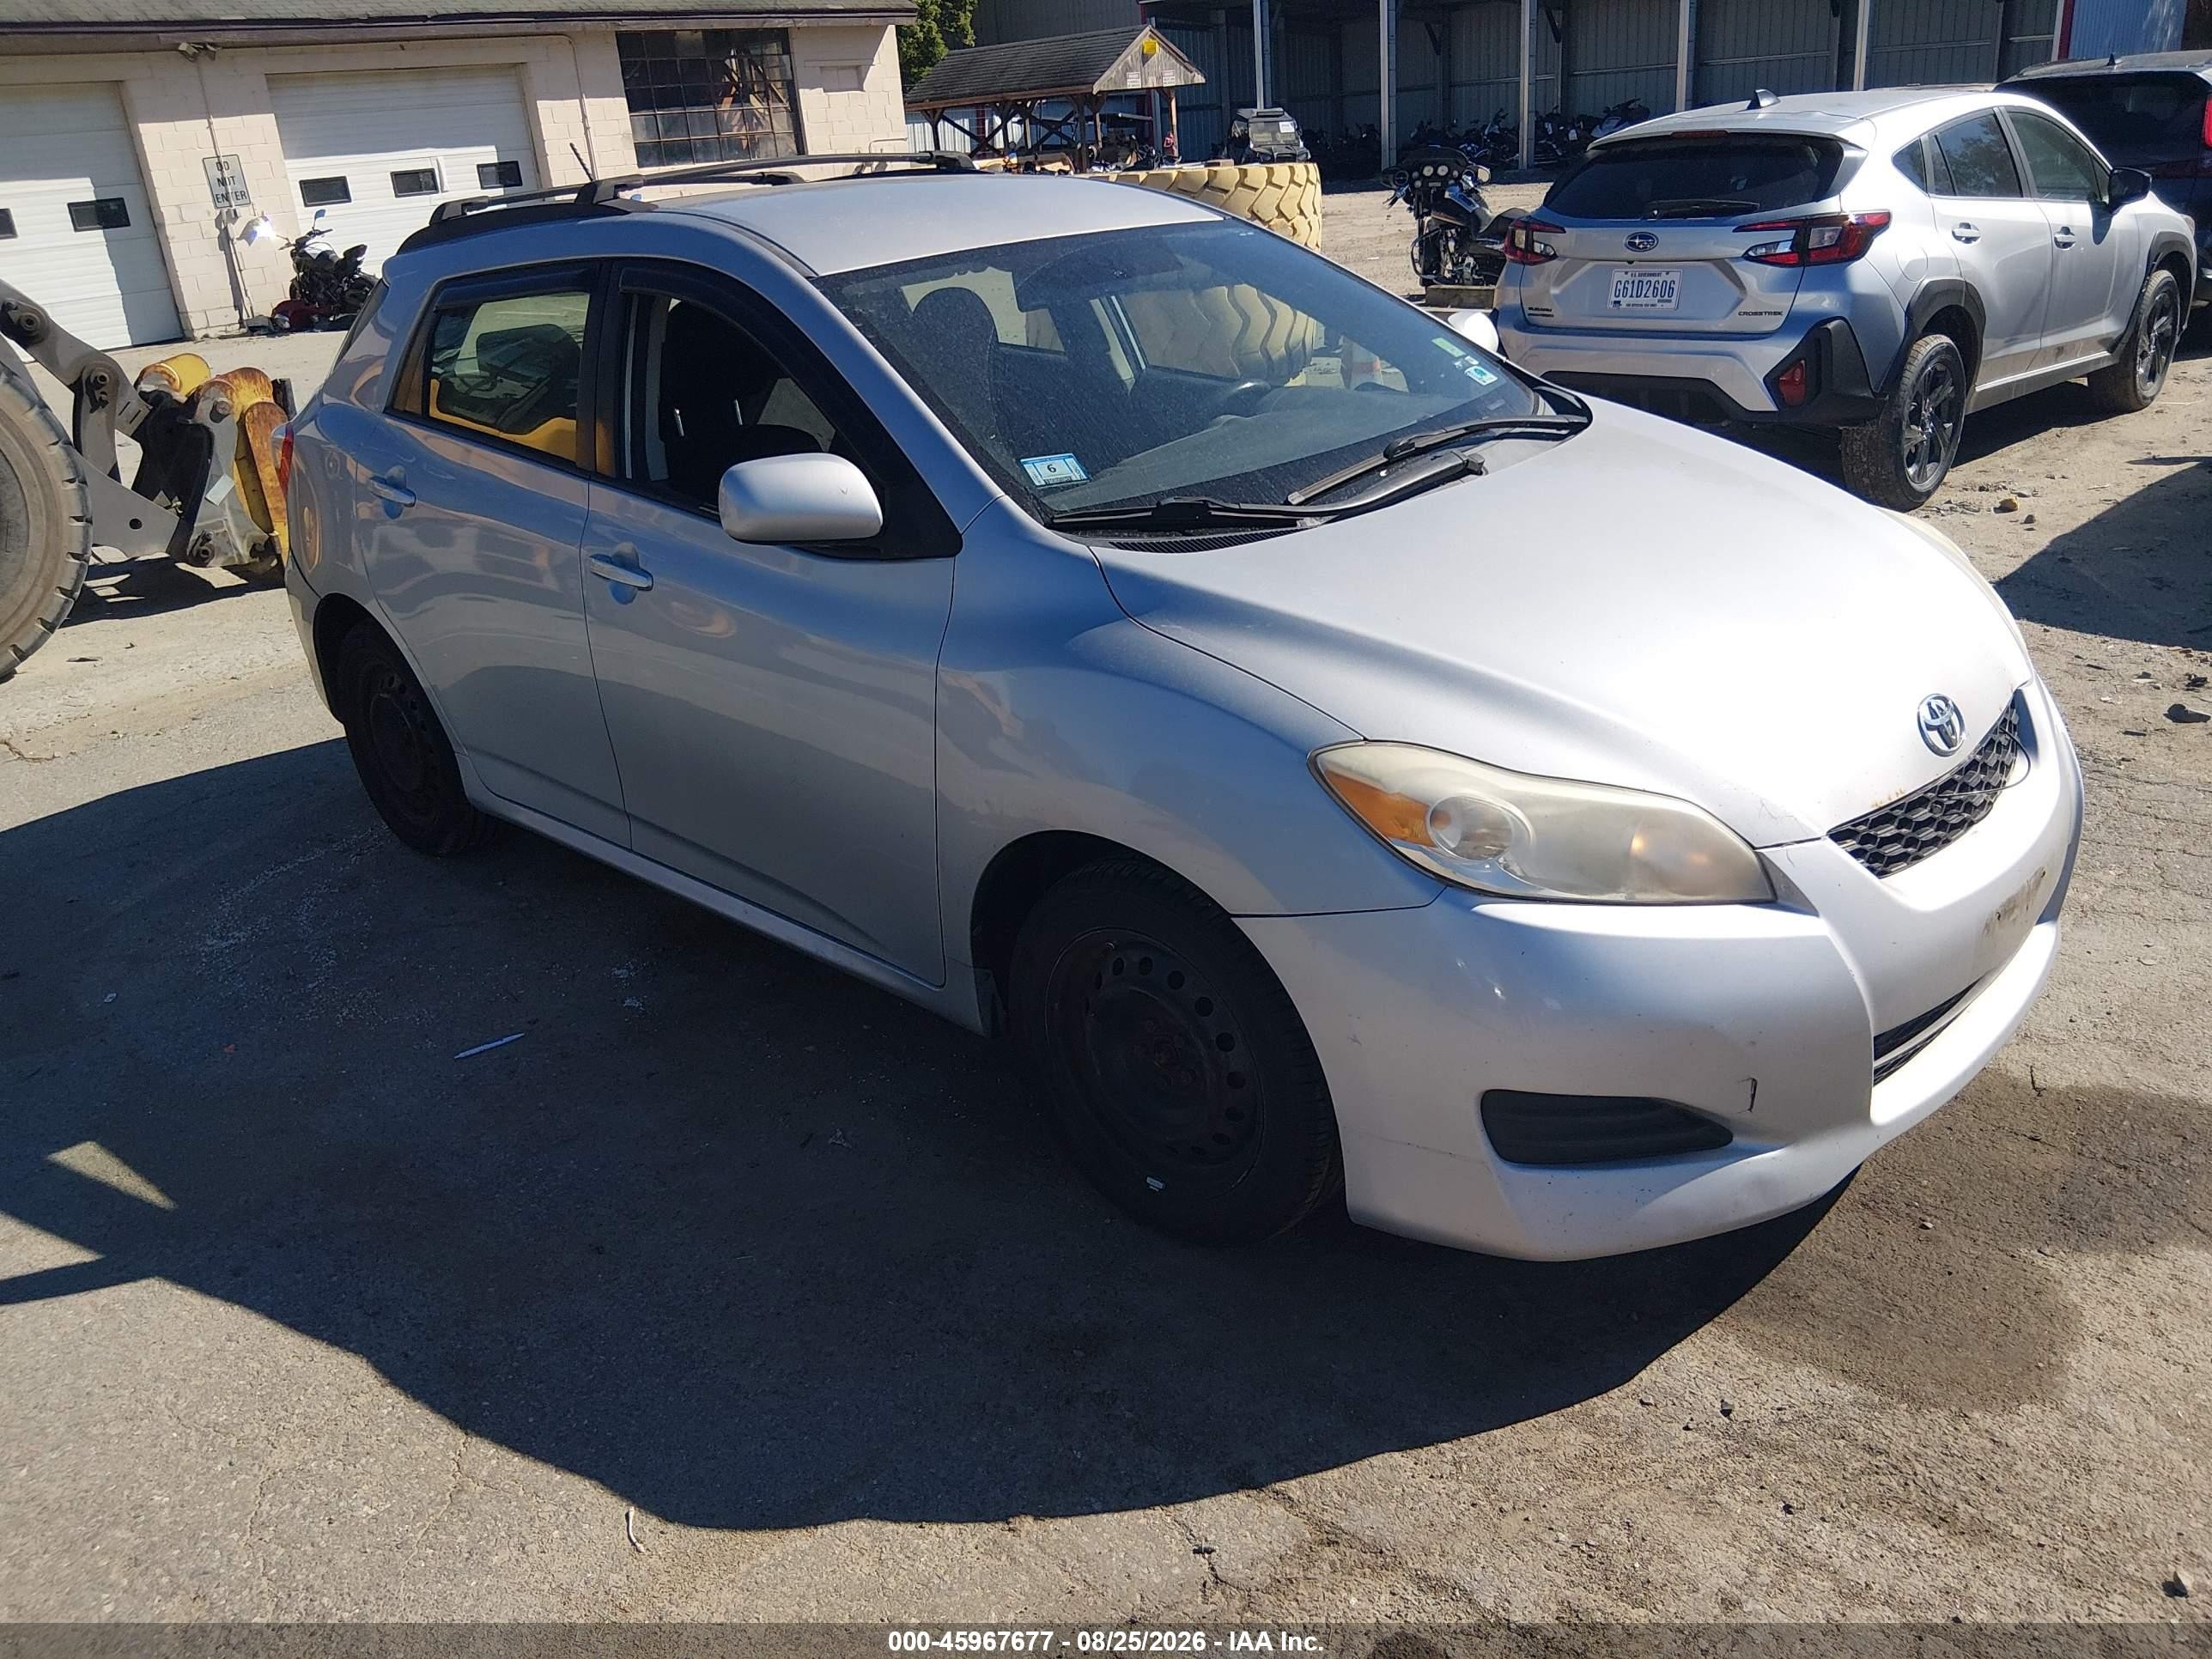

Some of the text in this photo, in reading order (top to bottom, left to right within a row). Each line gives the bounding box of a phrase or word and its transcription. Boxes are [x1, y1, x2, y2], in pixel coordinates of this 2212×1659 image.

[216, 161, 230, 172] DO
[1614, 280, 1675, 298] G61D2606
[1047, 464, 1057, 473] 6
